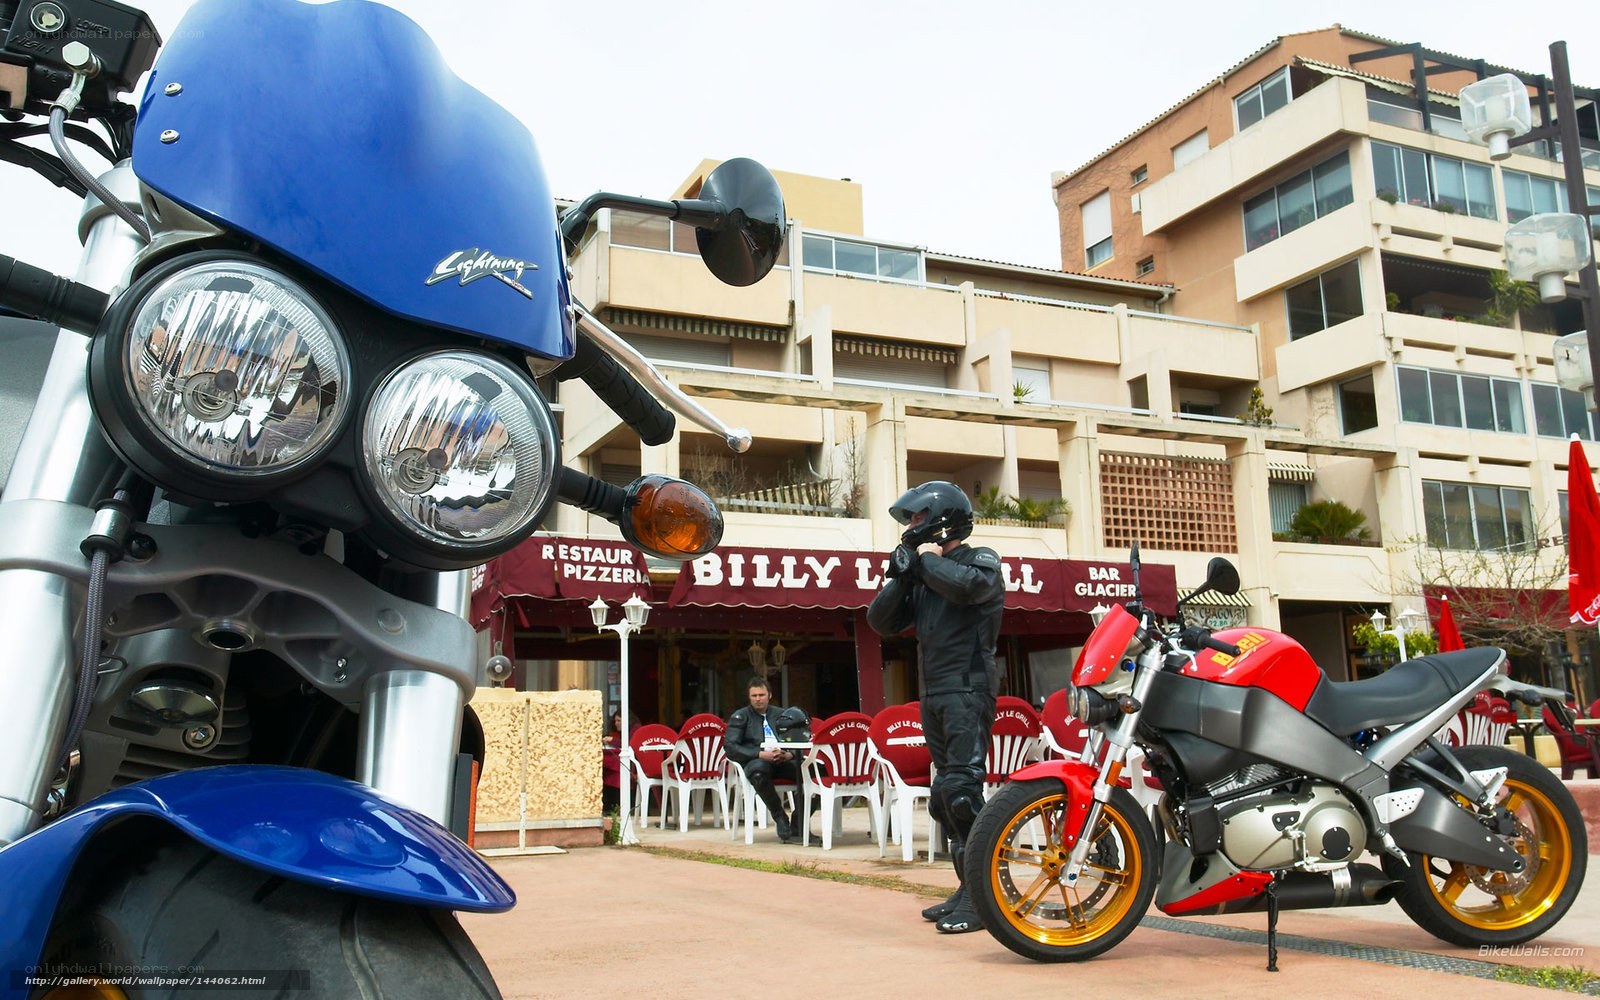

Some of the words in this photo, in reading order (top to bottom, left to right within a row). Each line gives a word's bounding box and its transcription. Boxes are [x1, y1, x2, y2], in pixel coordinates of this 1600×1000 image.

[435, 247, 525, 281] Lightning
[563, 563, 650, 586] PIZZERIA
[691, 552, 842, 588] BILLY
[1088, 566, 1121, 581] BAR
[1074, 582, 1136, 597] GLACIER
[1210, 631, 1266, 667] Bell
[886, 720, 901, 734] BILLY
[1005, 710, 1015, 718] LE
[1015, 711, 1030, 729] GRILL
[829, 723, 845, 737] BILLY
[856, 722, 870, 733] GRIL
